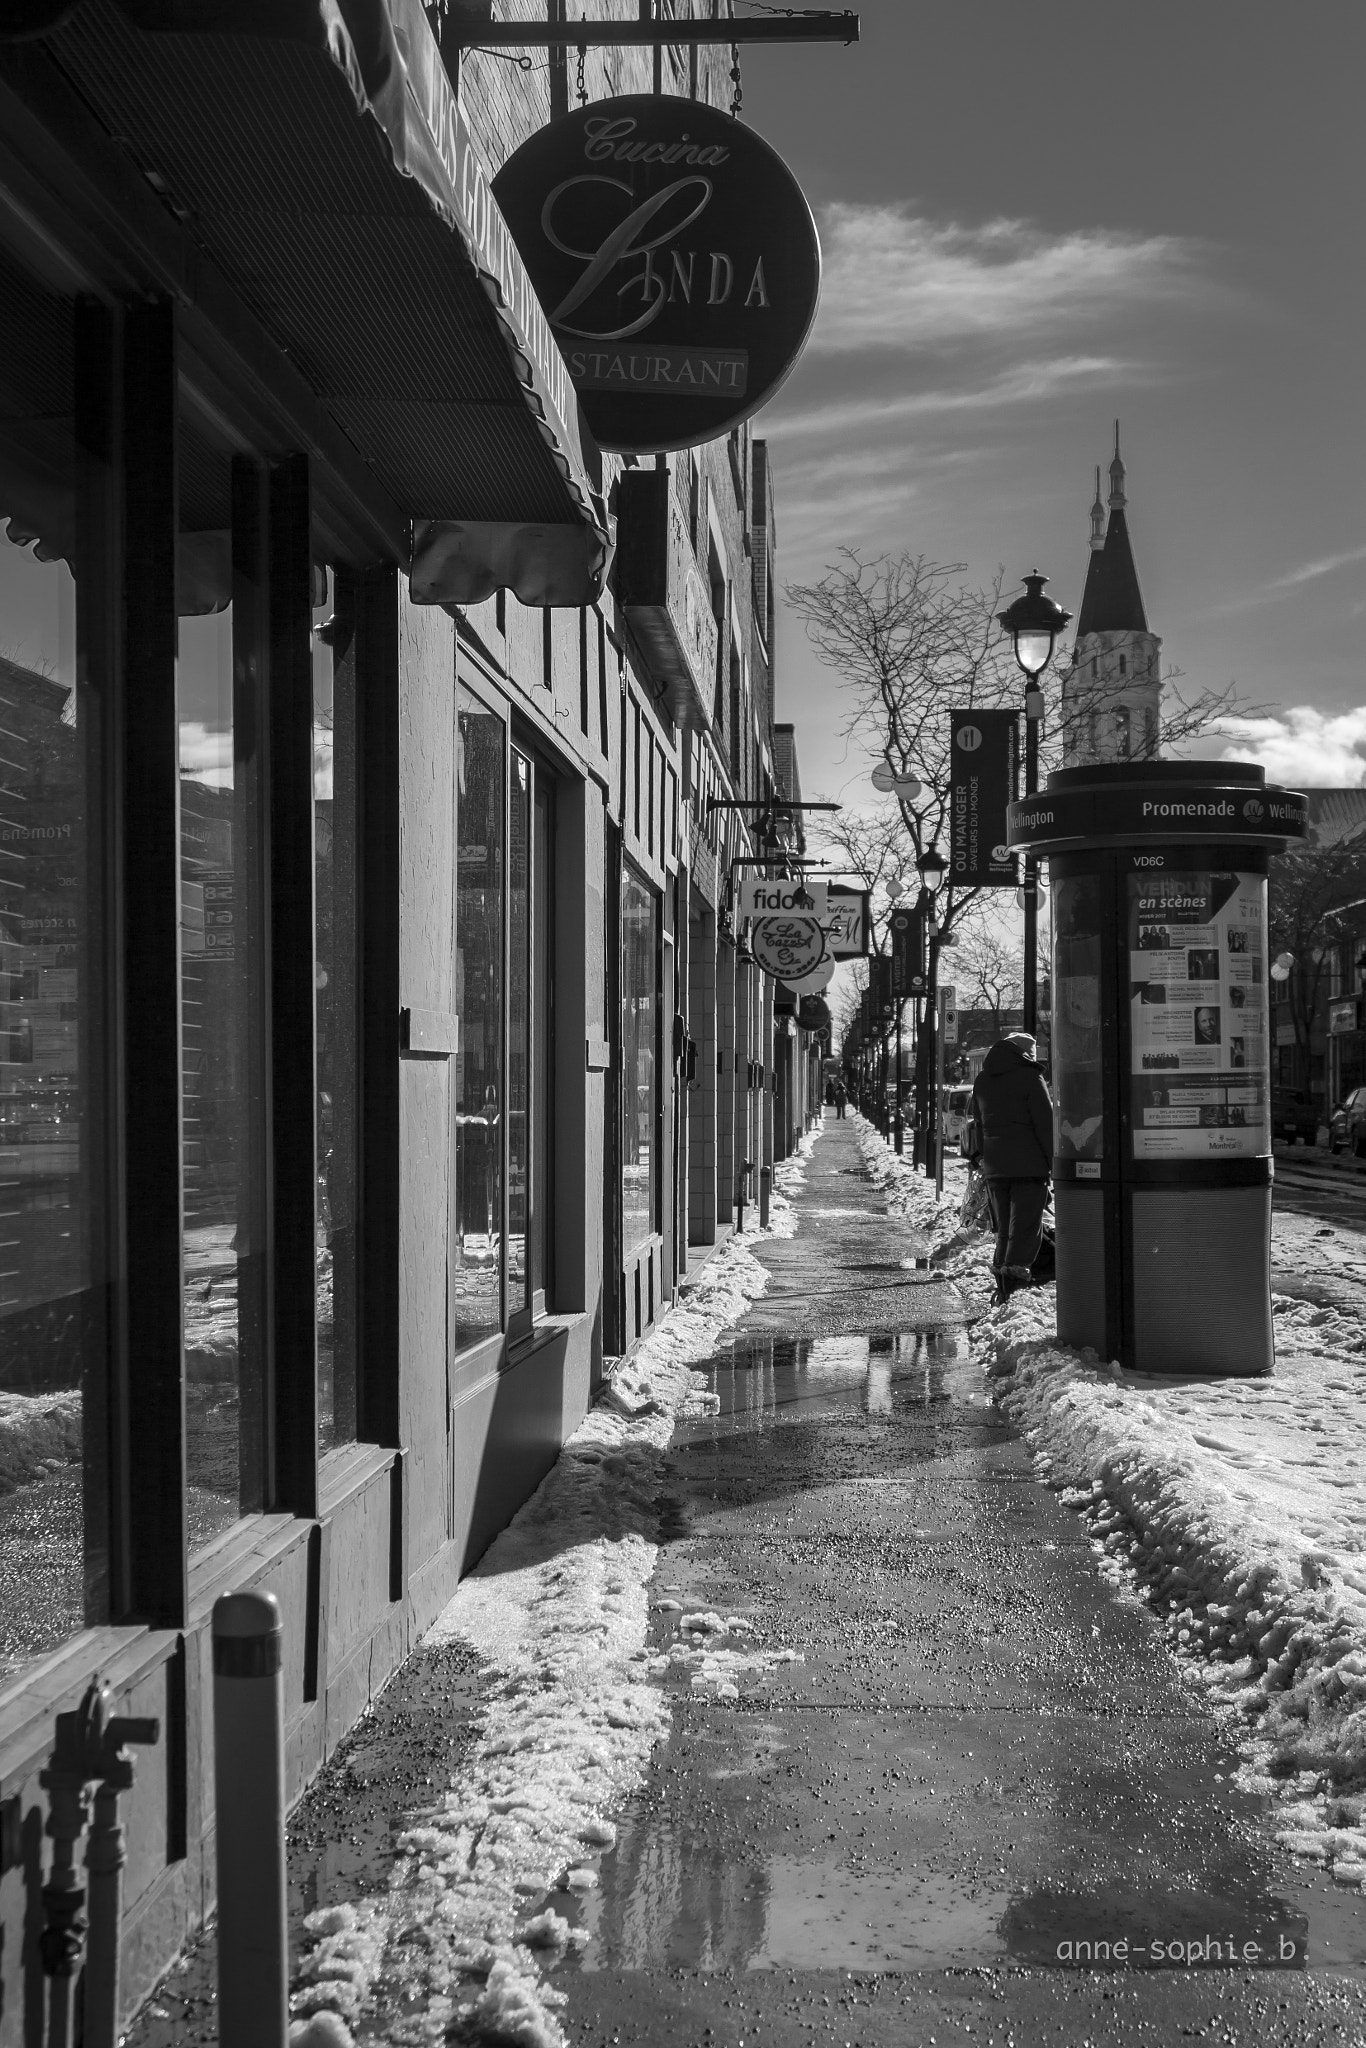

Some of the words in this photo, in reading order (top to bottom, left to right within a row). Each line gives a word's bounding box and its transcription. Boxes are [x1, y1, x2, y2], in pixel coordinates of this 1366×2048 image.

[584, 116, 730, 166] Cucina
[969, 776, 978, 811] MONDE
[955, 785, 967, 847] MANGER
[1142, 801, 1236, 817] Promenade
[969, 813, 978, 827] DU
[969, 829, 978, 871] SAVEURS
[953, 851, 967, 872] OÙ
[1133, 856, 1165, 867] VD6C
[753, 888, 795, 910] fido
[1138, 898, 1156, 908] en
[1159, 895, 1206, 908] scènes
[776, 922, 802, 938] La
